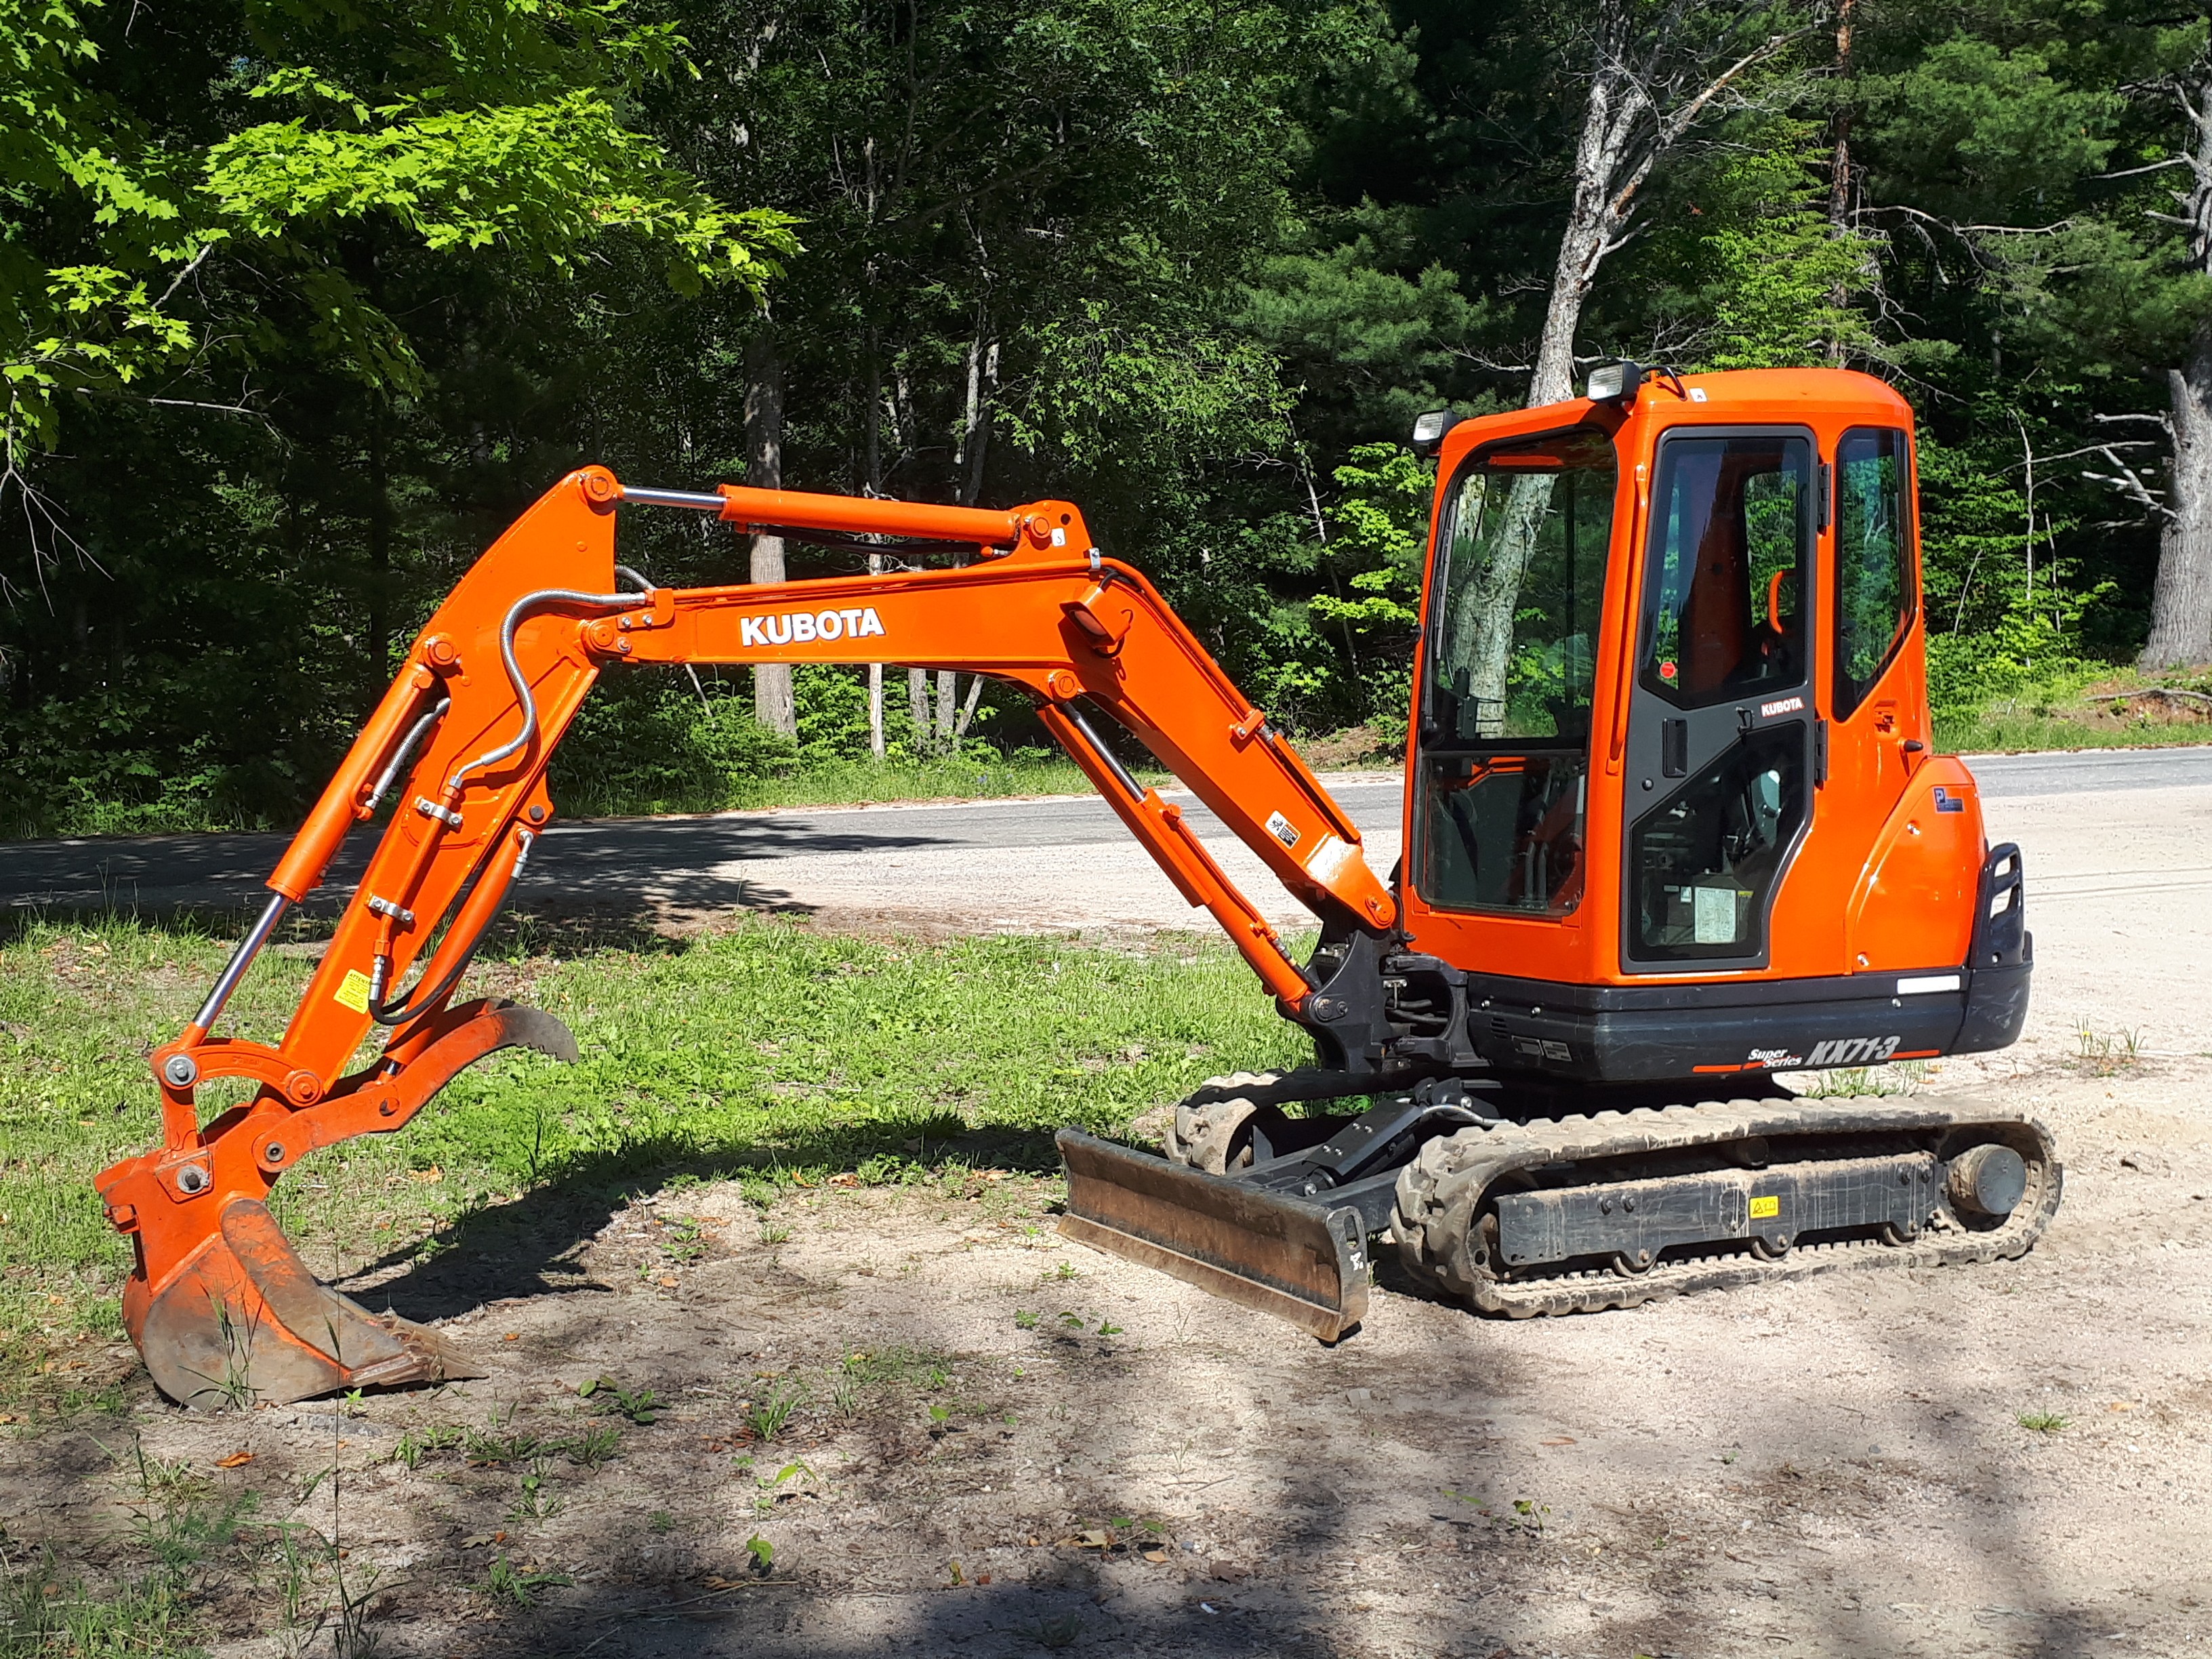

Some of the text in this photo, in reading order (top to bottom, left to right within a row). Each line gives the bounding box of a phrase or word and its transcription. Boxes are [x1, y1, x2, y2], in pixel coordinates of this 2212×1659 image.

[740, 608, 886, 647] KUBOTA
[1761, 697, 1804, 717] KUBOTA
[1748, 1048, 1788, 1062] Super
[1804, 1036, 1901, 1066] KX71-3
[1763, 1055, 1803, 1069] Series
